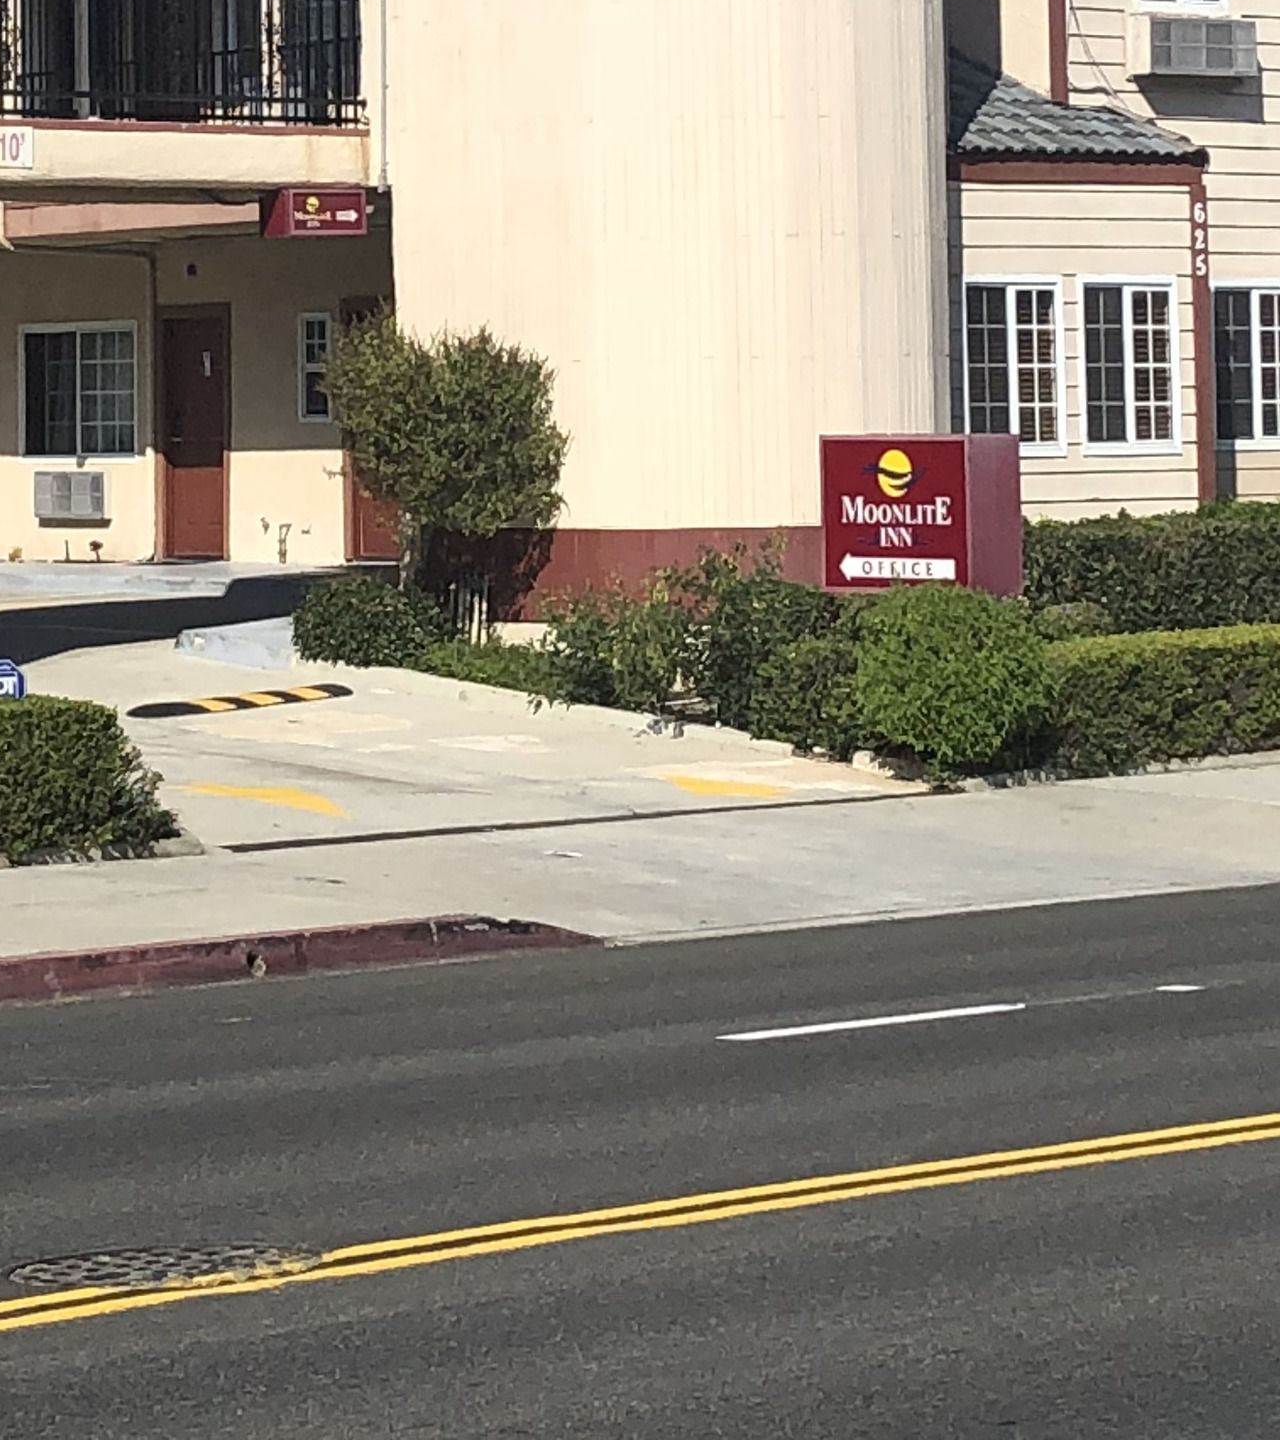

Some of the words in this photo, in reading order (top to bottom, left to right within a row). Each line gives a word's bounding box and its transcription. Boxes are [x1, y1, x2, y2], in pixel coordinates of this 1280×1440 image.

[1193, 202, 1207, 276] 625
[841, 495, 952, 525] MOONLITE
[879, 526, 912, 547] INN
[862, 560, 933, 577] OFFICE
